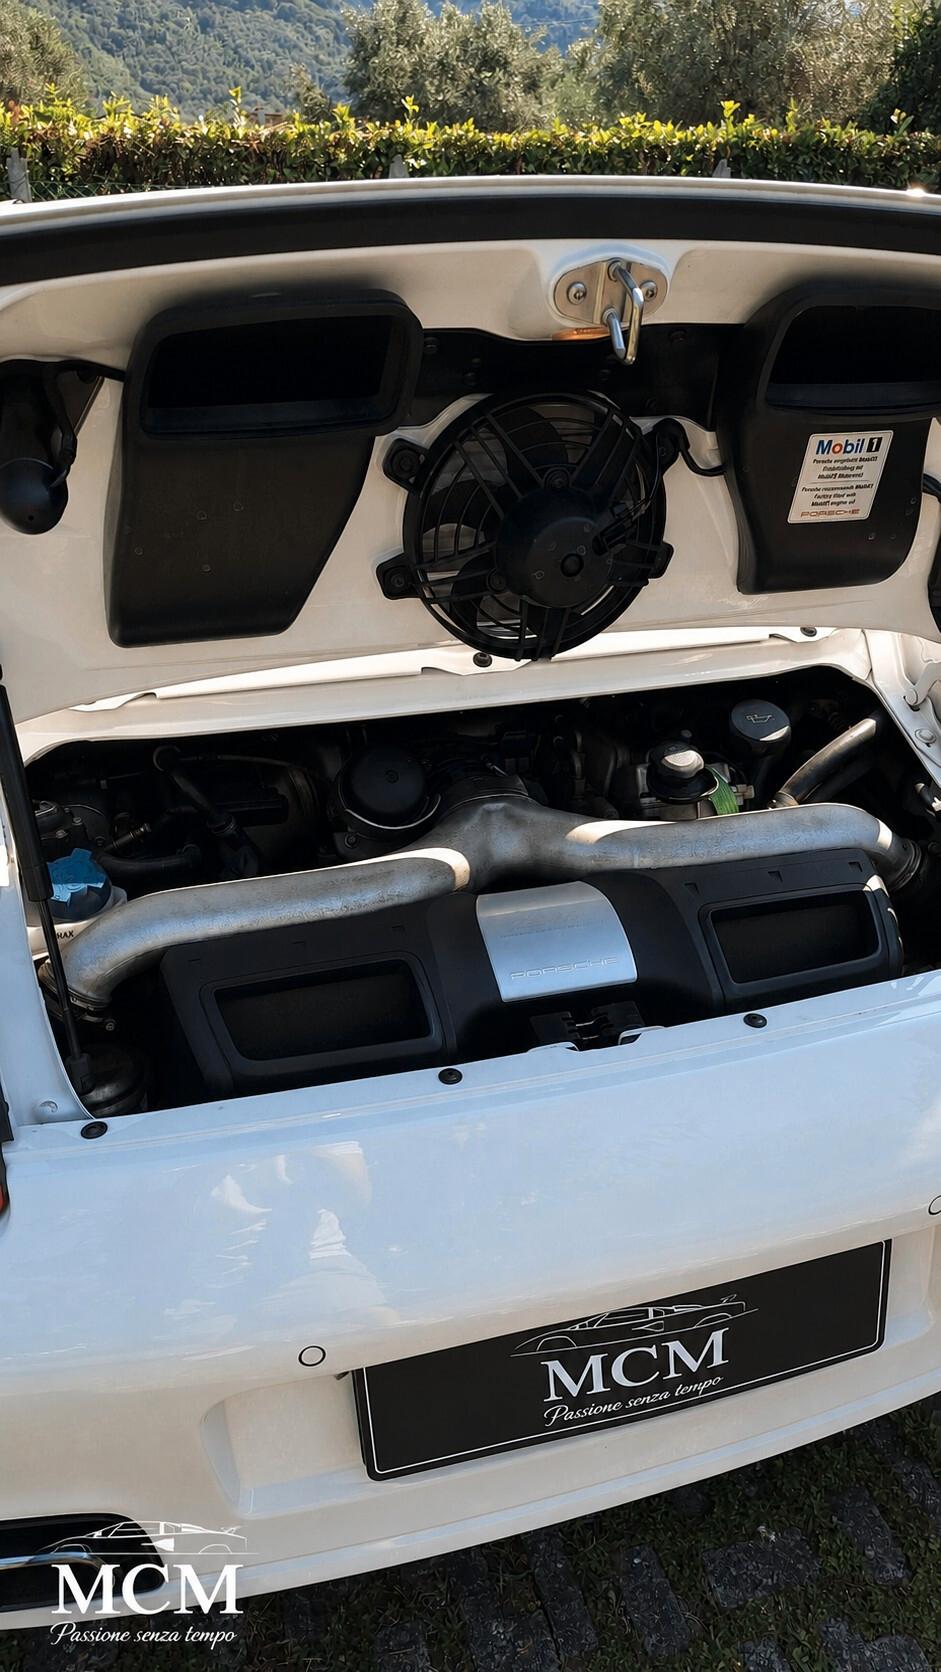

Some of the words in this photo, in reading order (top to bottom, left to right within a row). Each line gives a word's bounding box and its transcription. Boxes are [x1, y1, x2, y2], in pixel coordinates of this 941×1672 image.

[815, 438, 865, 455] Mobil
[511, 956, 617, 980] PORSCHE
[541, 1327, 730, 1402] MCM
[543, 1402, 623, 1427] Passione
[626, 1392, 670, 1408] senza
[674, 1376, 723, 1398] tempo
